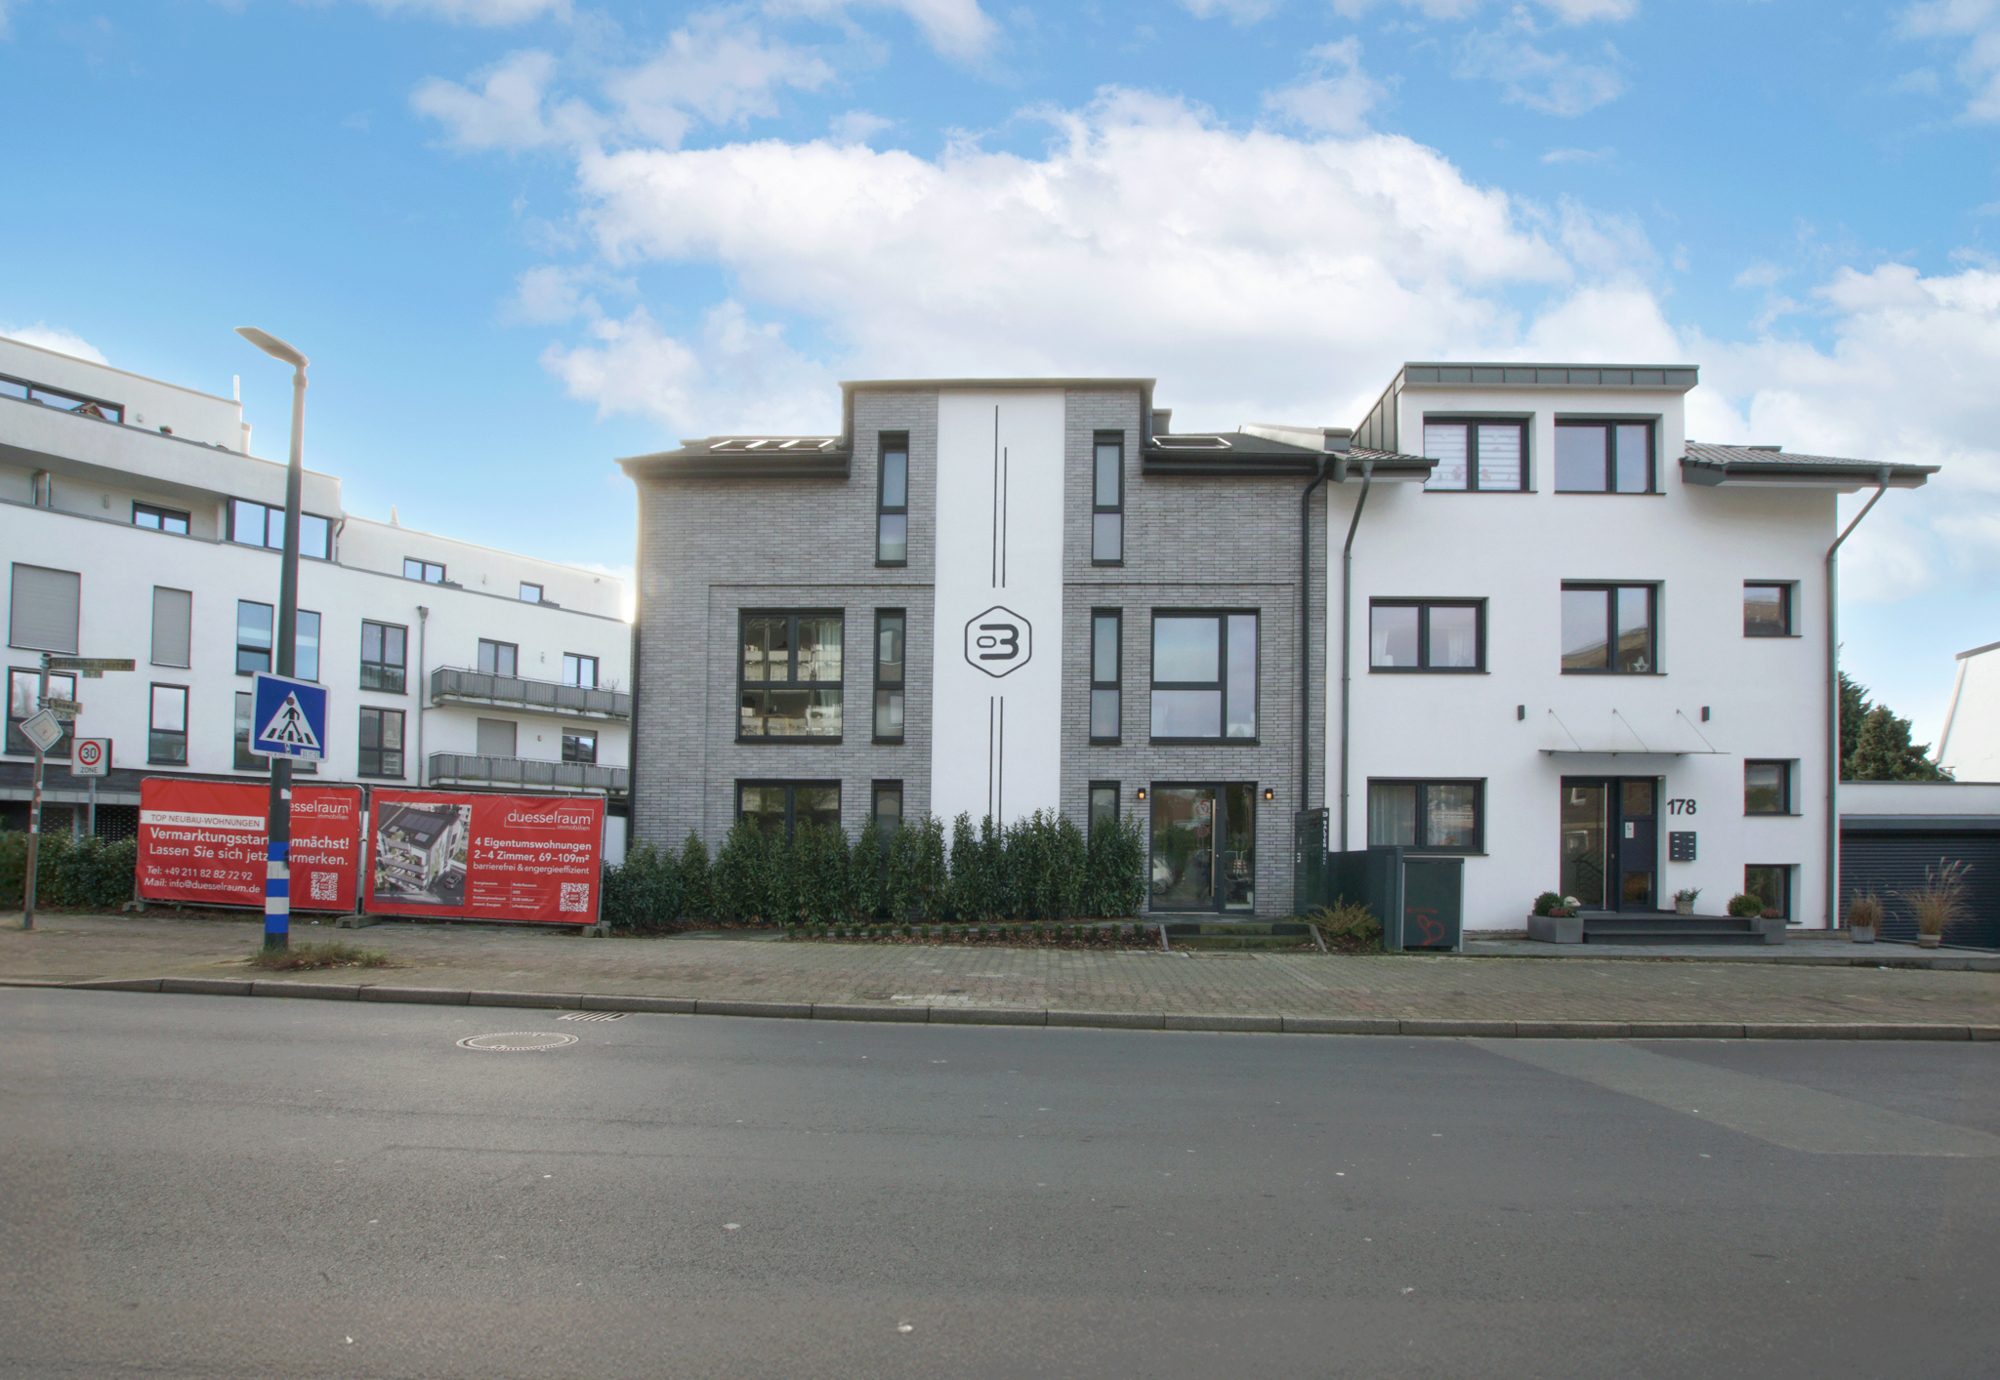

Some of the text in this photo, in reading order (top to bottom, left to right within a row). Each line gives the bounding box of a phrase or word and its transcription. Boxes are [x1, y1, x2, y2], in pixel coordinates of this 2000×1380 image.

[83, 747, 97, 759] 30
[80, 766, 99, 774] ZONE
[290, 799, 349, 814] esselraum
[1666, 798, 1697, 815] 178
[151, 813, 261, 828] TOP NEUBAU-WOHNUNGEN
[507, 808, 591, 825] duesselraum
[291, 835, 350, 849] mnächst!
[474, 836, 592, 853] 4 Eigentumswohnungen
[149, 842, 348, 866] Lassen Sie sich jetz rmerken.
[496, 850, 536, 863] Zimmer,
[146, 865, 253, 882] Tel: +49 211 82 82 72 92
[472, 861, 516, 872] barrierefrei
[517, 863, 524, 872] &
[143, 877, 261, 894] Mail: info@duesselraum.de
